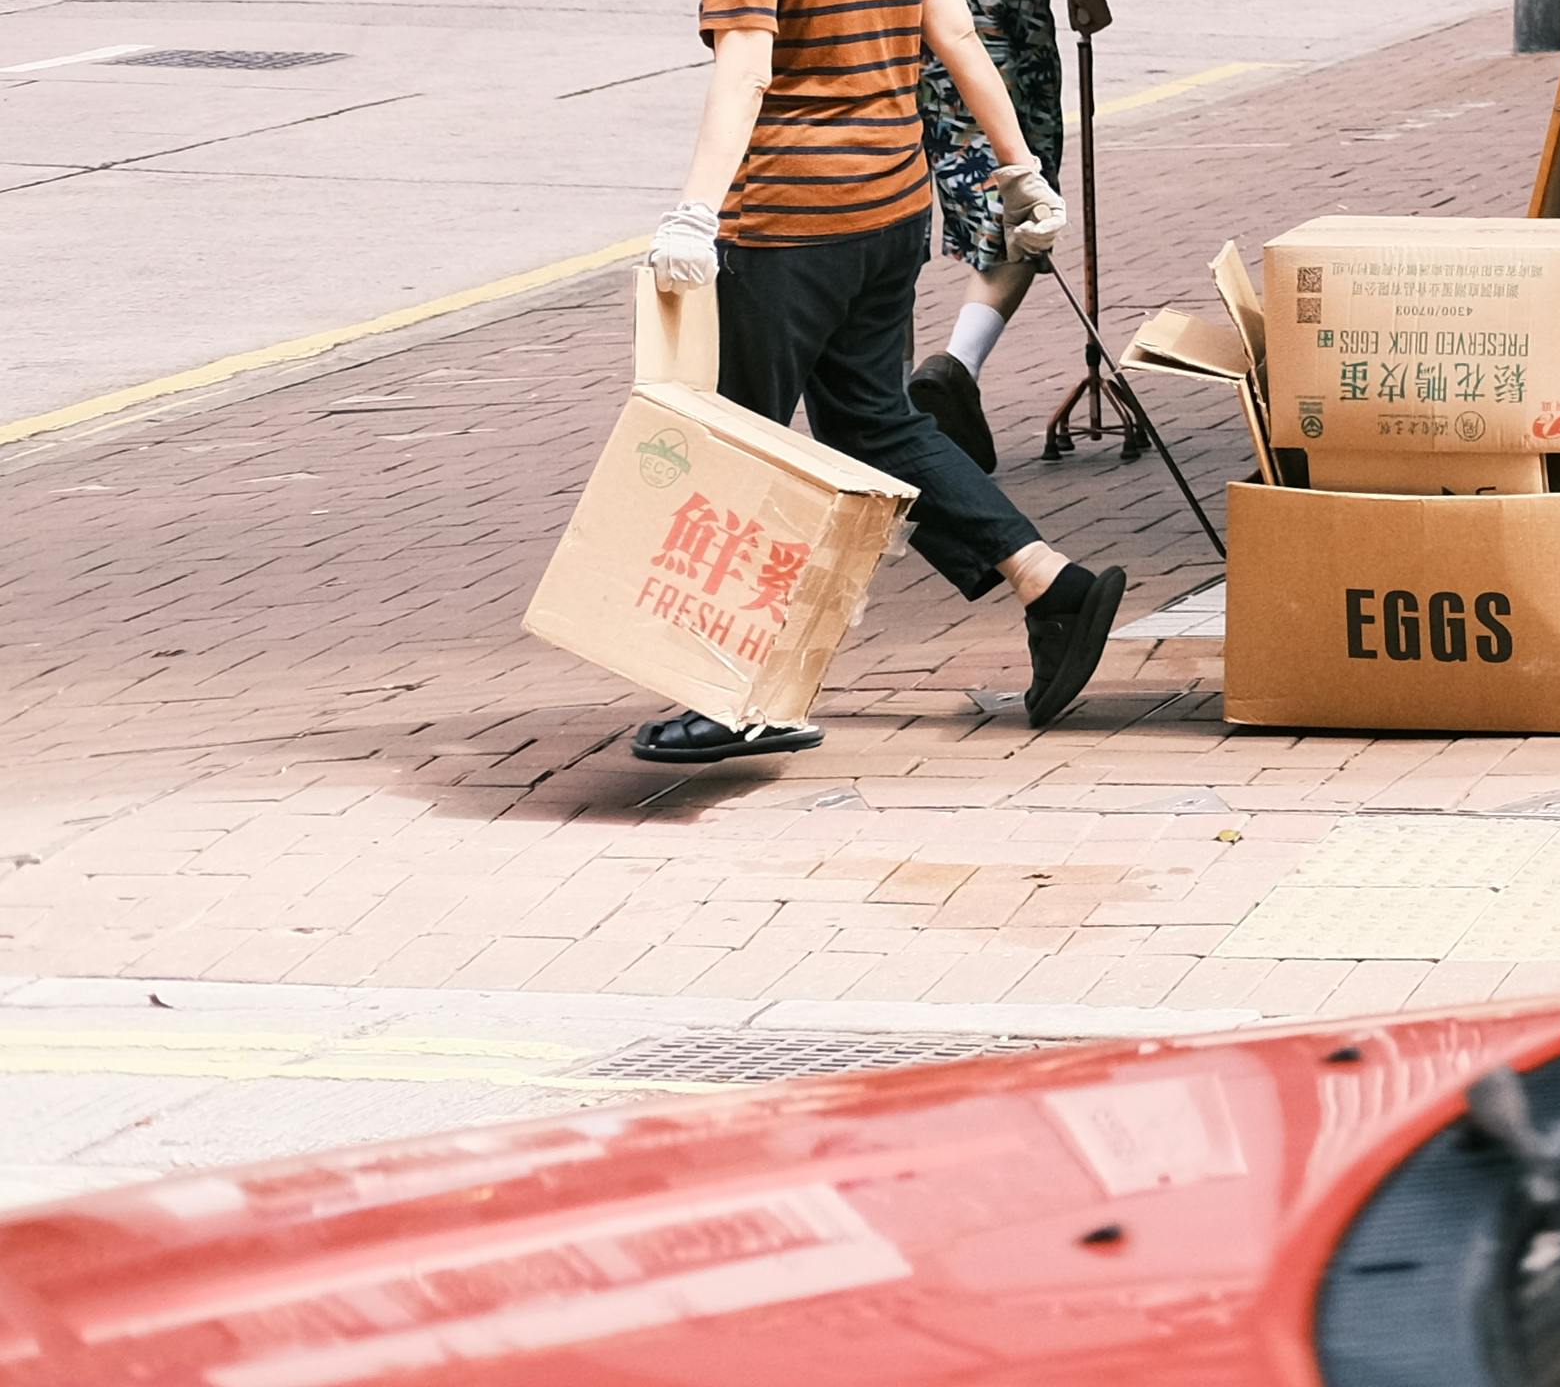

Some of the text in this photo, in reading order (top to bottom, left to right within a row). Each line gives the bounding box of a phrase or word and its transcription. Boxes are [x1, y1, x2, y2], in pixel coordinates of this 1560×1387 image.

[1339, 329, 1529, 358] PRESERVED DUCK EGGS
[1339, 360, 1528, 404] 鬆花鴨皮蛋
[641, 455, 677, 479] ECO
[635, 575, 737, 647] FRESH
[1345, 588, 1514, 664] EGGS
